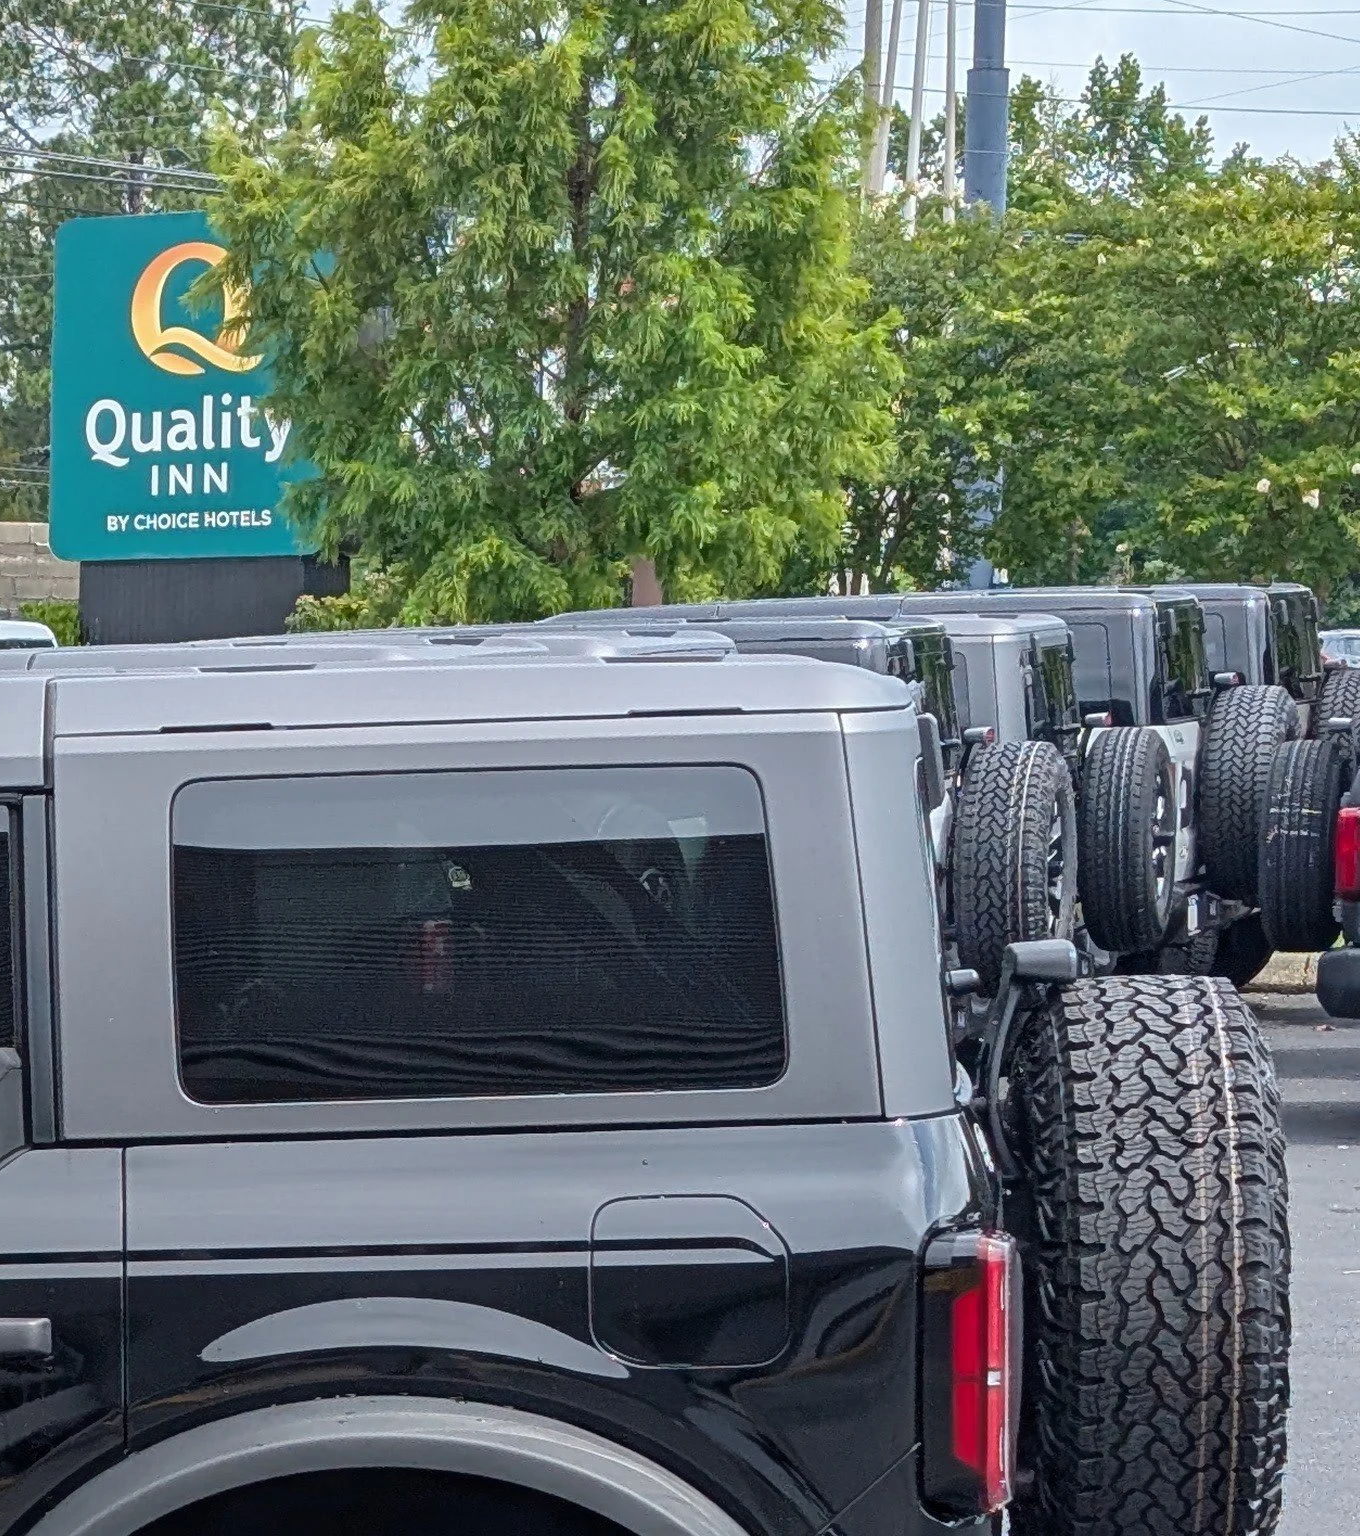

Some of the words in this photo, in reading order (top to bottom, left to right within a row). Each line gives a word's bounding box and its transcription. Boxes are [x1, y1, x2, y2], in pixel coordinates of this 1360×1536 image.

[85, 392, 293, 468] Quality
[150, 462, 229, 497] INN
[106, 513, 131, 532] BY
[134, 511, 200, 530] CHOICE
[204, 509, 273, 529] HOTELS
